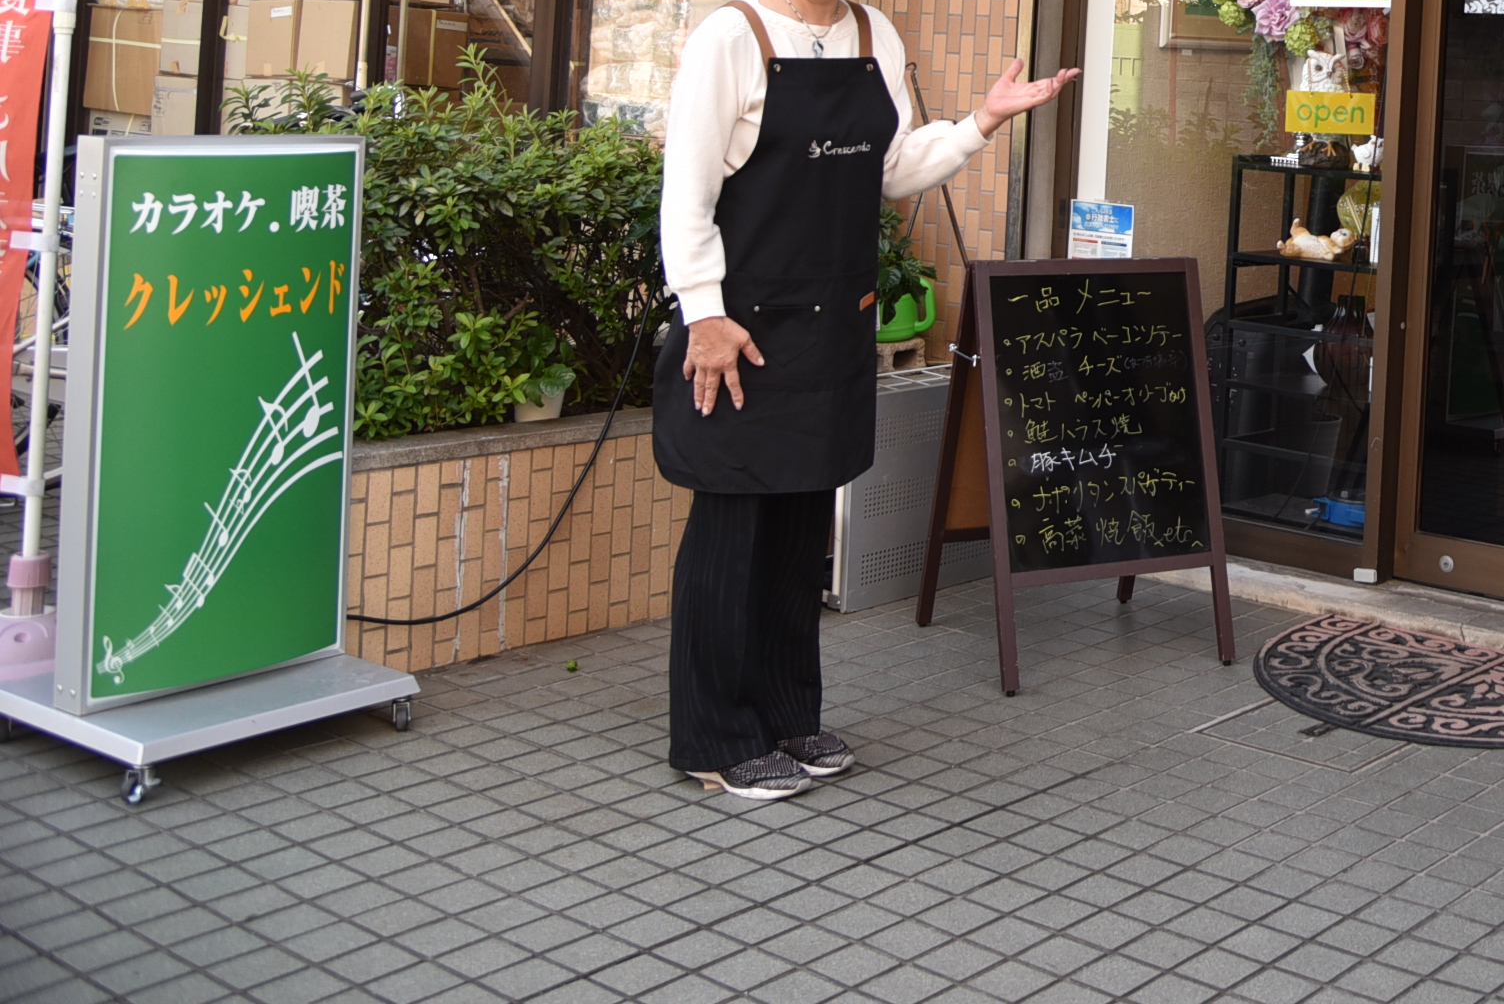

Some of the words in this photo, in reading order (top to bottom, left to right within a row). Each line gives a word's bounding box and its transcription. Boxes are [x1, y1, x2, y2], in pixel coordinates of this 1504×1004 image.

[1296, 102, 1365, 129] open
[822, 140, 871, 156] Crescendo
[123, 259, 345, 331] クレッシェンド
